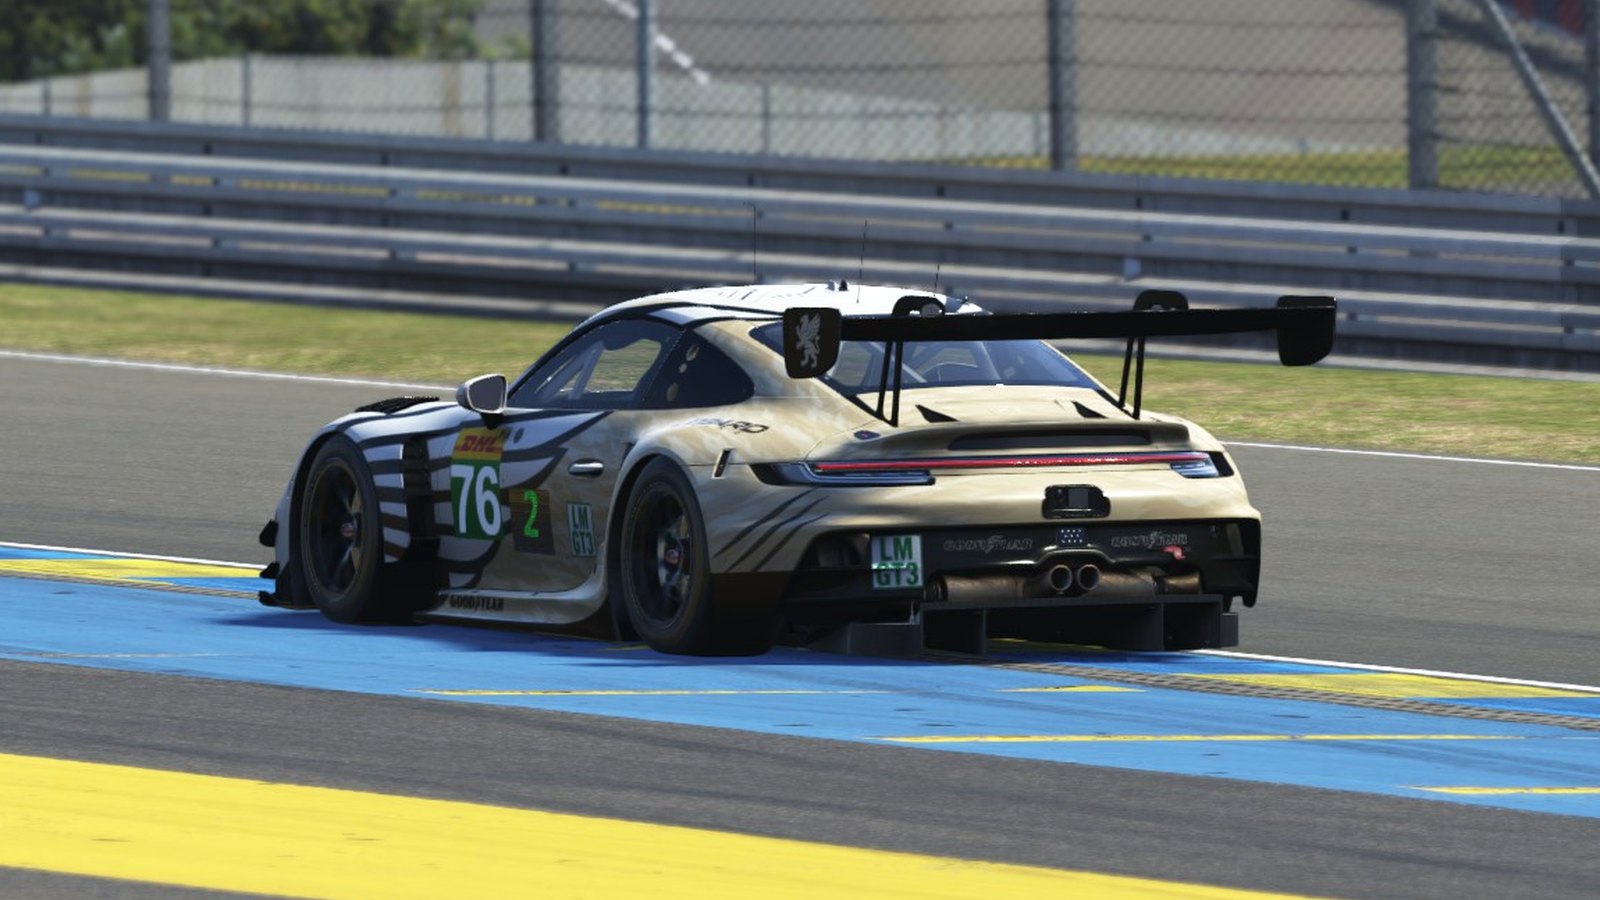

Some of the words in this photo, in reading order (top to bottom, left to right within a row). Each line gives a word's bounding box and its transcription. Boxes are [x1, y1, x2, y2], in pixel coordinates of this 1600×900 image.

[458, 435, 497, 452] DHL
[451, 464, 502, 536] 76
[523, 489, 539, 538] 2
[572, 505, 589, 529] LM
[572, 530, 593, 554] GT3
[880, 538, 912, 561] LM
[876, 561, 918, 586] GT3
